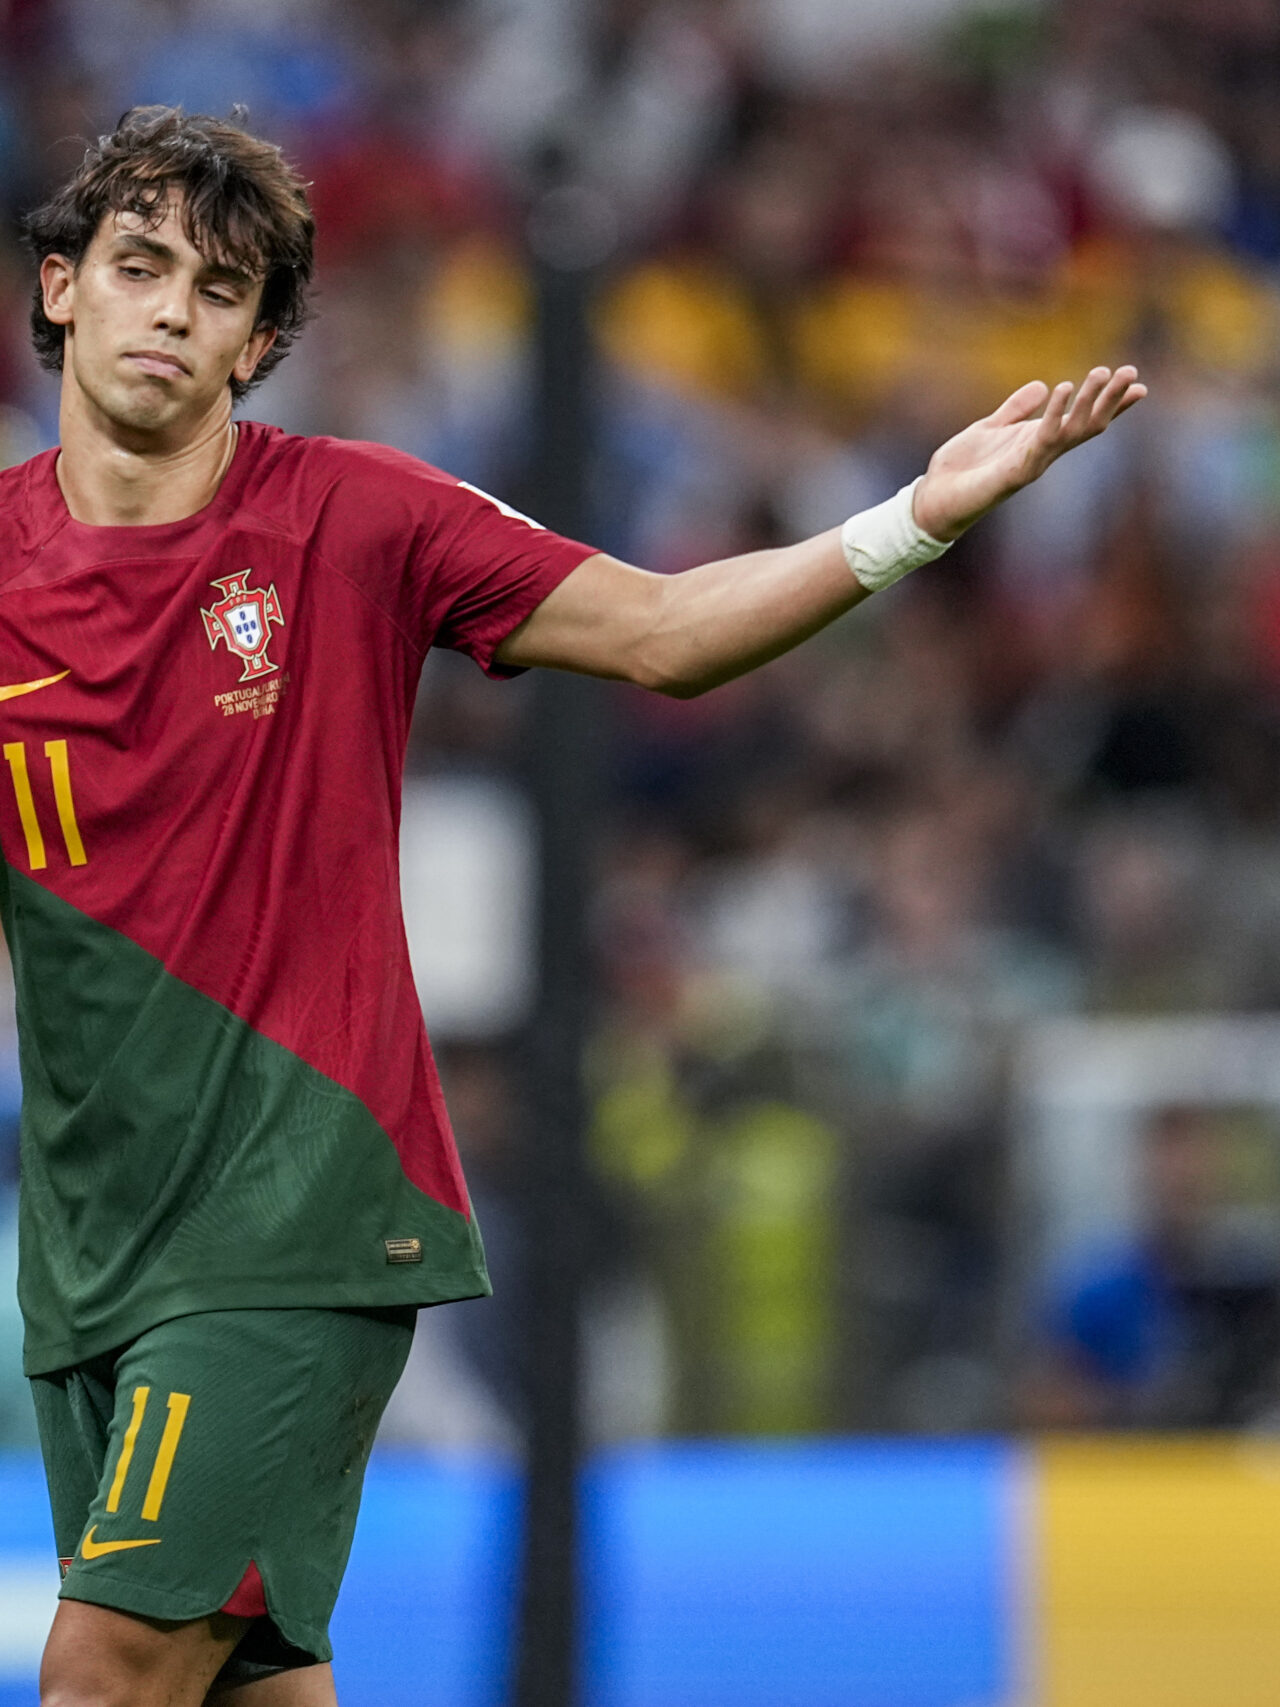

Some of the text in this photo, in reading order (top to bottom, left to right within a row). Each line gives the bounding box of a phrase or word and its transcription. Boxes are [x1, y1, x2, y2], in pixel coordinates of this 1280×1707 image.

[252, 704, 275, 719] DHA
[3, 739, 87, 870] 11
[106, 1386, 191, 1522] 11
